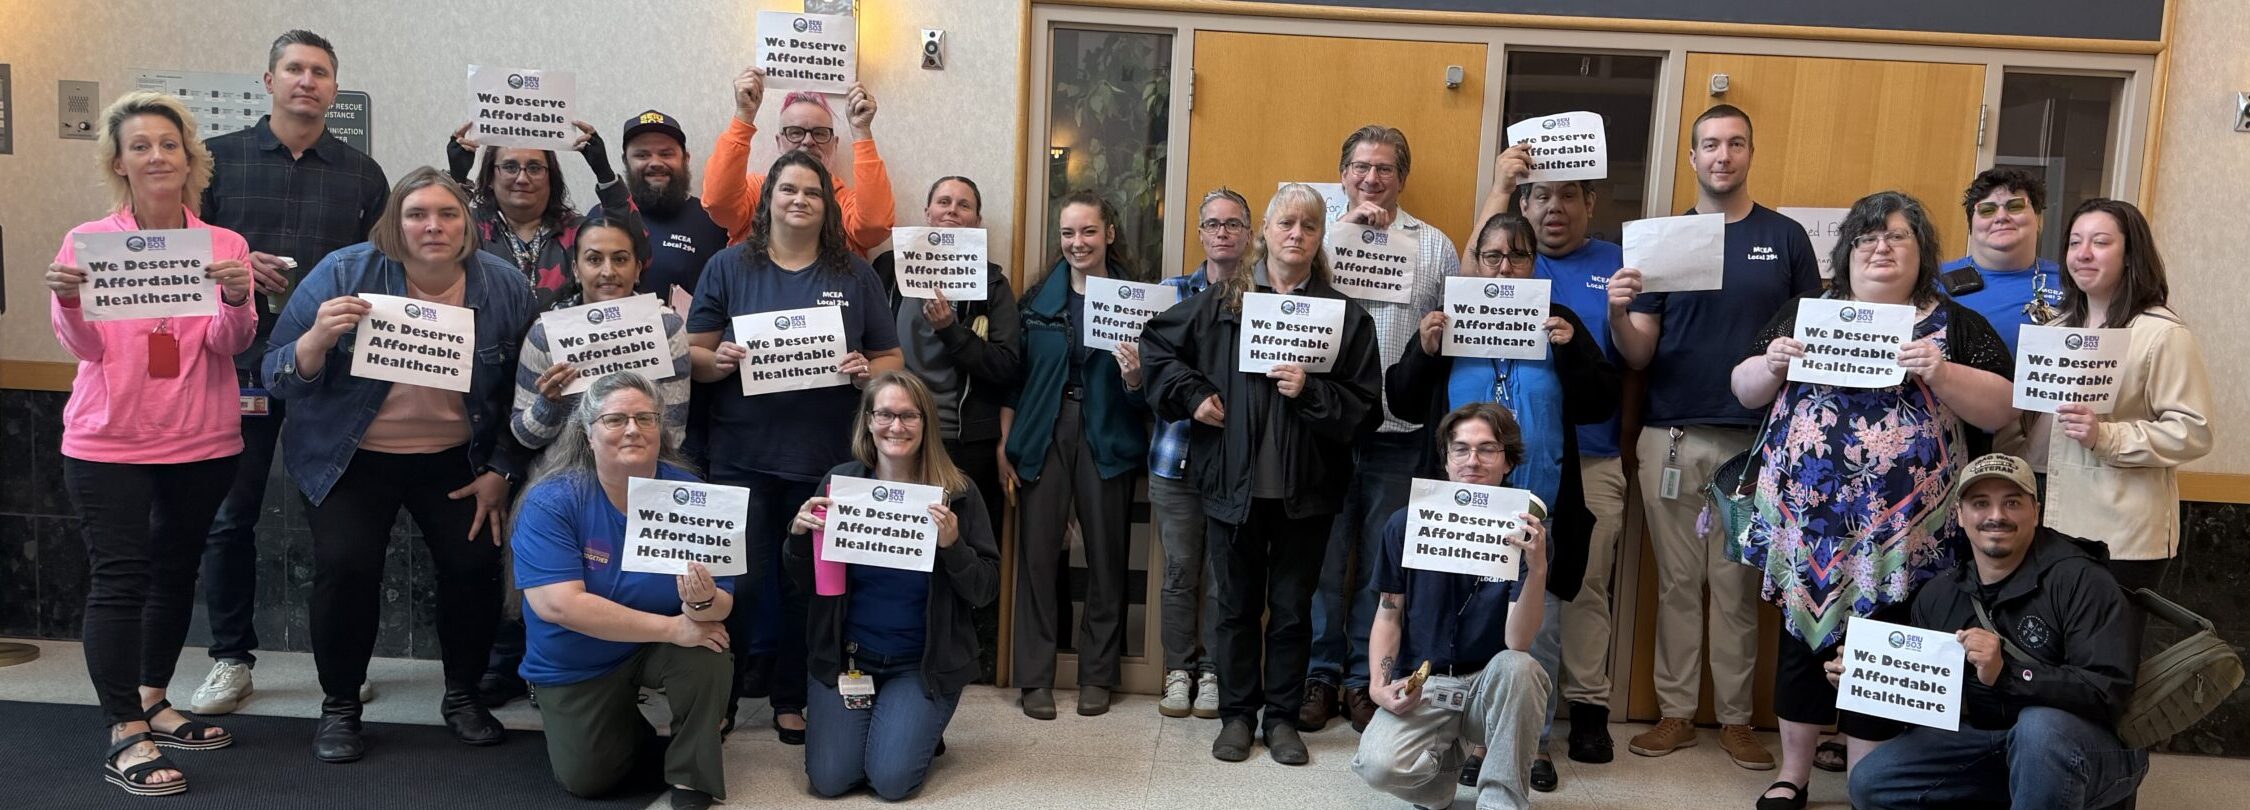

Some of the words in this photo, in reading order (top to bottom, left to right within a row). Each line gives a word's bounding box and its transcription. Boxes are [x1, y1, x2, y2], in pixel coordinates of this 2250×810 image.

[765, 37, 785, 47] We
[790, 38, 847, 52] Deserve
[766, 52, 845, 66] Affordable
[766, 67, 845, 81] Healthcare
[335, 103, 363, 111] RESCUE
[477, 93, 500, 104] We
[504, 95, 566, 108] Deserve
[324, 111, 356, 119] ISTANCE
[480, 108, 565, 123] Affordable
[480, 124, 565, 139] Healthcare
[1541, 132, 1595, 143] Deserve
[1530, 144, 1595, 156] ffordable
[1530, 159, 1596, 170] ealthcare
[662, 240, 682, 248] Local
[670, 234, 692, 243] MCEA
[902, 251, 922, 260] We
[925, 252, 978, 261] Deserve
[1335, 246, 1353, 257] We
[1356, 249, 1407, 263] Deserve
[88, 261, 118, 272] We
[124, 259, 201, 271] Deserve
[904, 265, 976, 275] Affordable
[1334, 261, 1403, 277] Affordable
[94, 275, 200, 289] Affordable
[906, 279, 976, 289] Healthcare
[1332, 275, 1402, 291] Healthcare
[1586, 281, 1604, 290] Local
[95, 292, 202, 307] Healthcare
[1092, 300, 1110, 311] We
[1113, 304, 1158, 317] Deserv
[1453, 303, 1475, 314] We
[1479, 304, 1539, 316] Deserve
[1092, 315, 1142, 330] Afforda
[1251, 319, 1271, 329] We
[1276, 321, 1333, 335] Deserve
[1454, 319, 1536, 331] Affordable
[371, 318, 395, 333] We
[400, 324, 464, 344] Deserve
[559, 336, 584, 349] We
[588, 325, 653, 343] Deserve
[1092, 328, 1140, 343] Healthc
[1805, 326, 1828, 338] We
[1832, 329, 1899, 344] Deserve
[746, 339, 770, 350] We
[774, 334, 835, 347] Deserve
[1251, 334, 1329, 350] Affordable
[1453, 334, 1535, 346] Healthcare
[368, 336, 461, 360] Affordable
[567, 340, 655, 363] Affordable
[1804, 343, 1896, 360] Affordable
[751, 349, 835, 365] Affordable
[1250, 349, 1326, 363] Healthcare
[2028, 354, 2053, 366] We
[2058, 357, 2117, 369] Deserve
[366, 353, 459, 376] Healthcare
[580, 357, 659, 378] ealthcare
[1802, 359, 1893, 375] Healthcare
[753, 365, 837, 381] Healthcare
[2027, 371, 2113, 386] Affordable
[2026, 387, 2109, 402] Healthcare
[1996, 455, 2015, 463] WAR
[1974, 466, 2013, 474] VETERAN
[690, 496, 706, 504] 503
[638, 509, 664, 522] We
[668, 512, 734, 529] Deserve
[838, 504, 861, 516] We
[865, 508, 928, 524] Deserve
[1419, 509, 1443, 521] We
[1448, 512, 1515, 529] Deserve
[639, 527, 731, 547] Affordable
[837, 521, 925, 540] Affordable
[1418, 526, 1510, 546] Affordable
[835, 537, 922, 556] Healthcare
[1416, 543, 1508, 563] Healthcare
[637, 545, 732, 564] Healthcare
[1906, 641, 1922, 649] 503
[1907, 634, 1923, 643] SEIU
[1853, 649, 1876, 663] We
[1881, 654, 1951, 677] Deserve
[1852, 667, 1947, 695] Affordable
[1850, 684, 1945, 713] Healthcare
